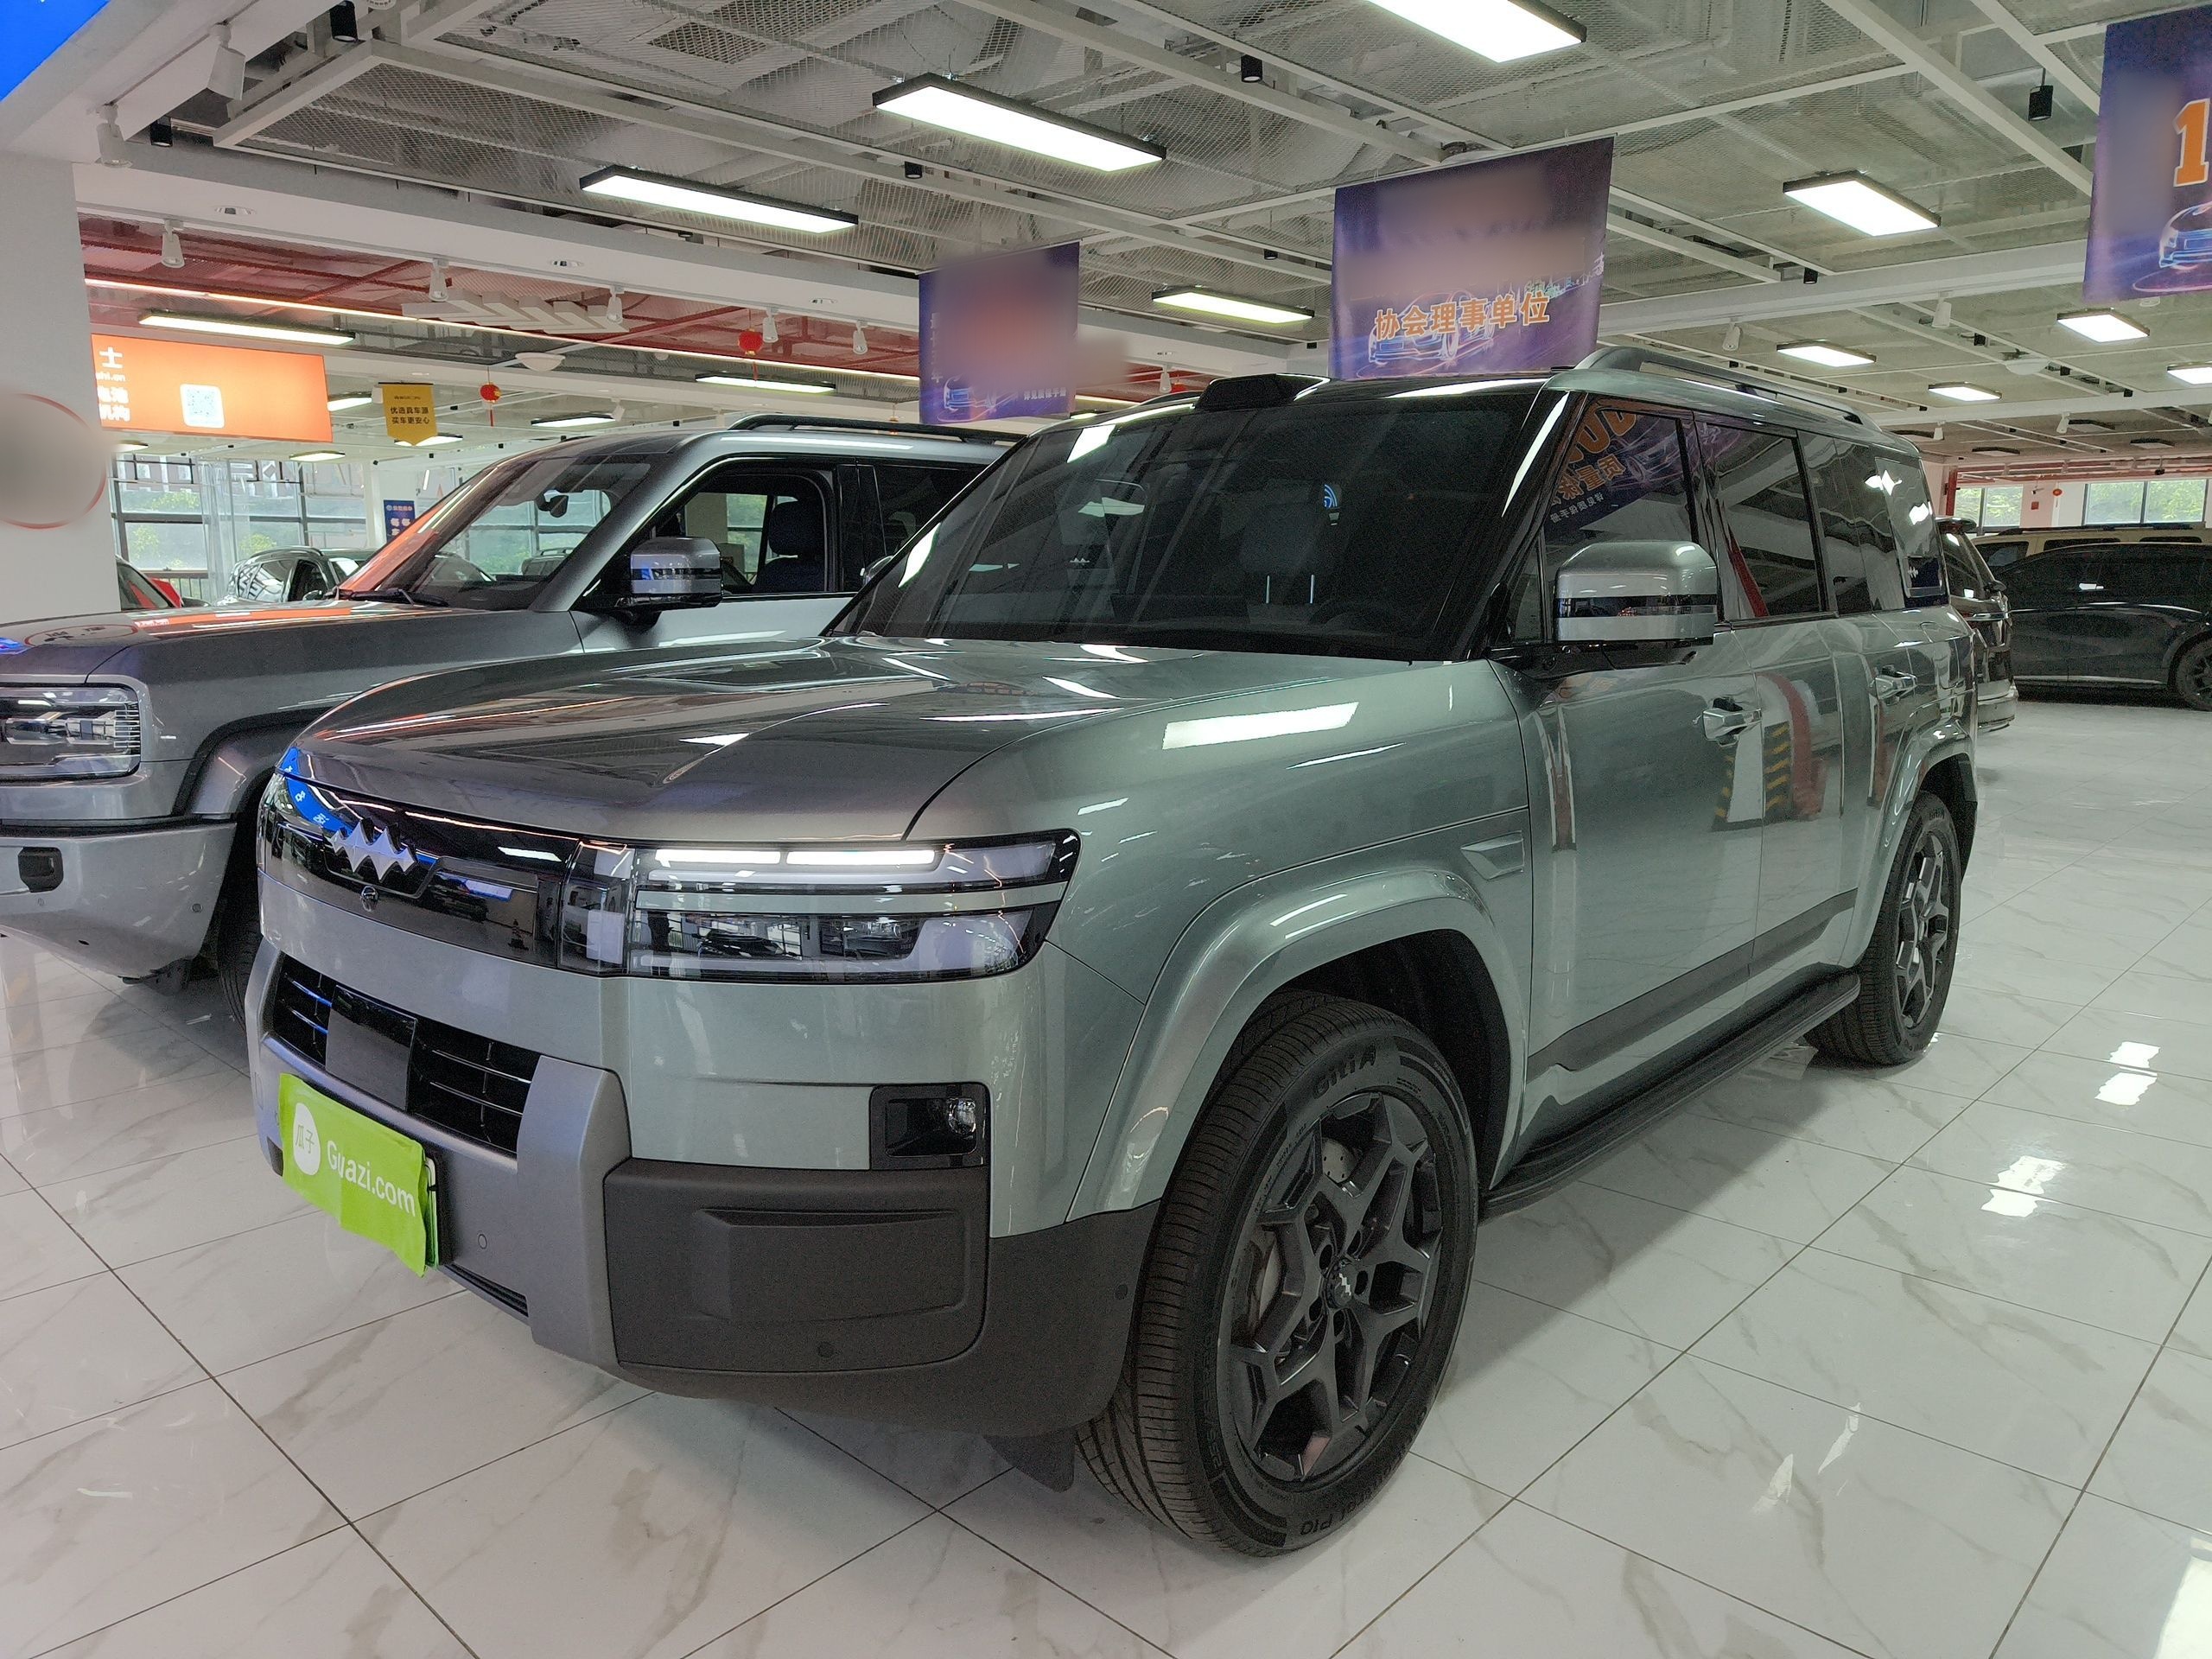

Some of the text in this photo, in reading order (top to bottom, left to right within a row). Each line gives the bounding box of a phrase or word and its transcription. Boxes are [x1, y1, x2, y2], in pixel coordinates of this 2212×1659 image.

[2173, 98, 2210, 187] 1
[1376, 290, 1550, 340] 协会理事单位
[99, 346, 123, 369] 士
[295, 1124, 315, 1154] 瓜子
[327, 1140, 416, 1217] Guazi.com
